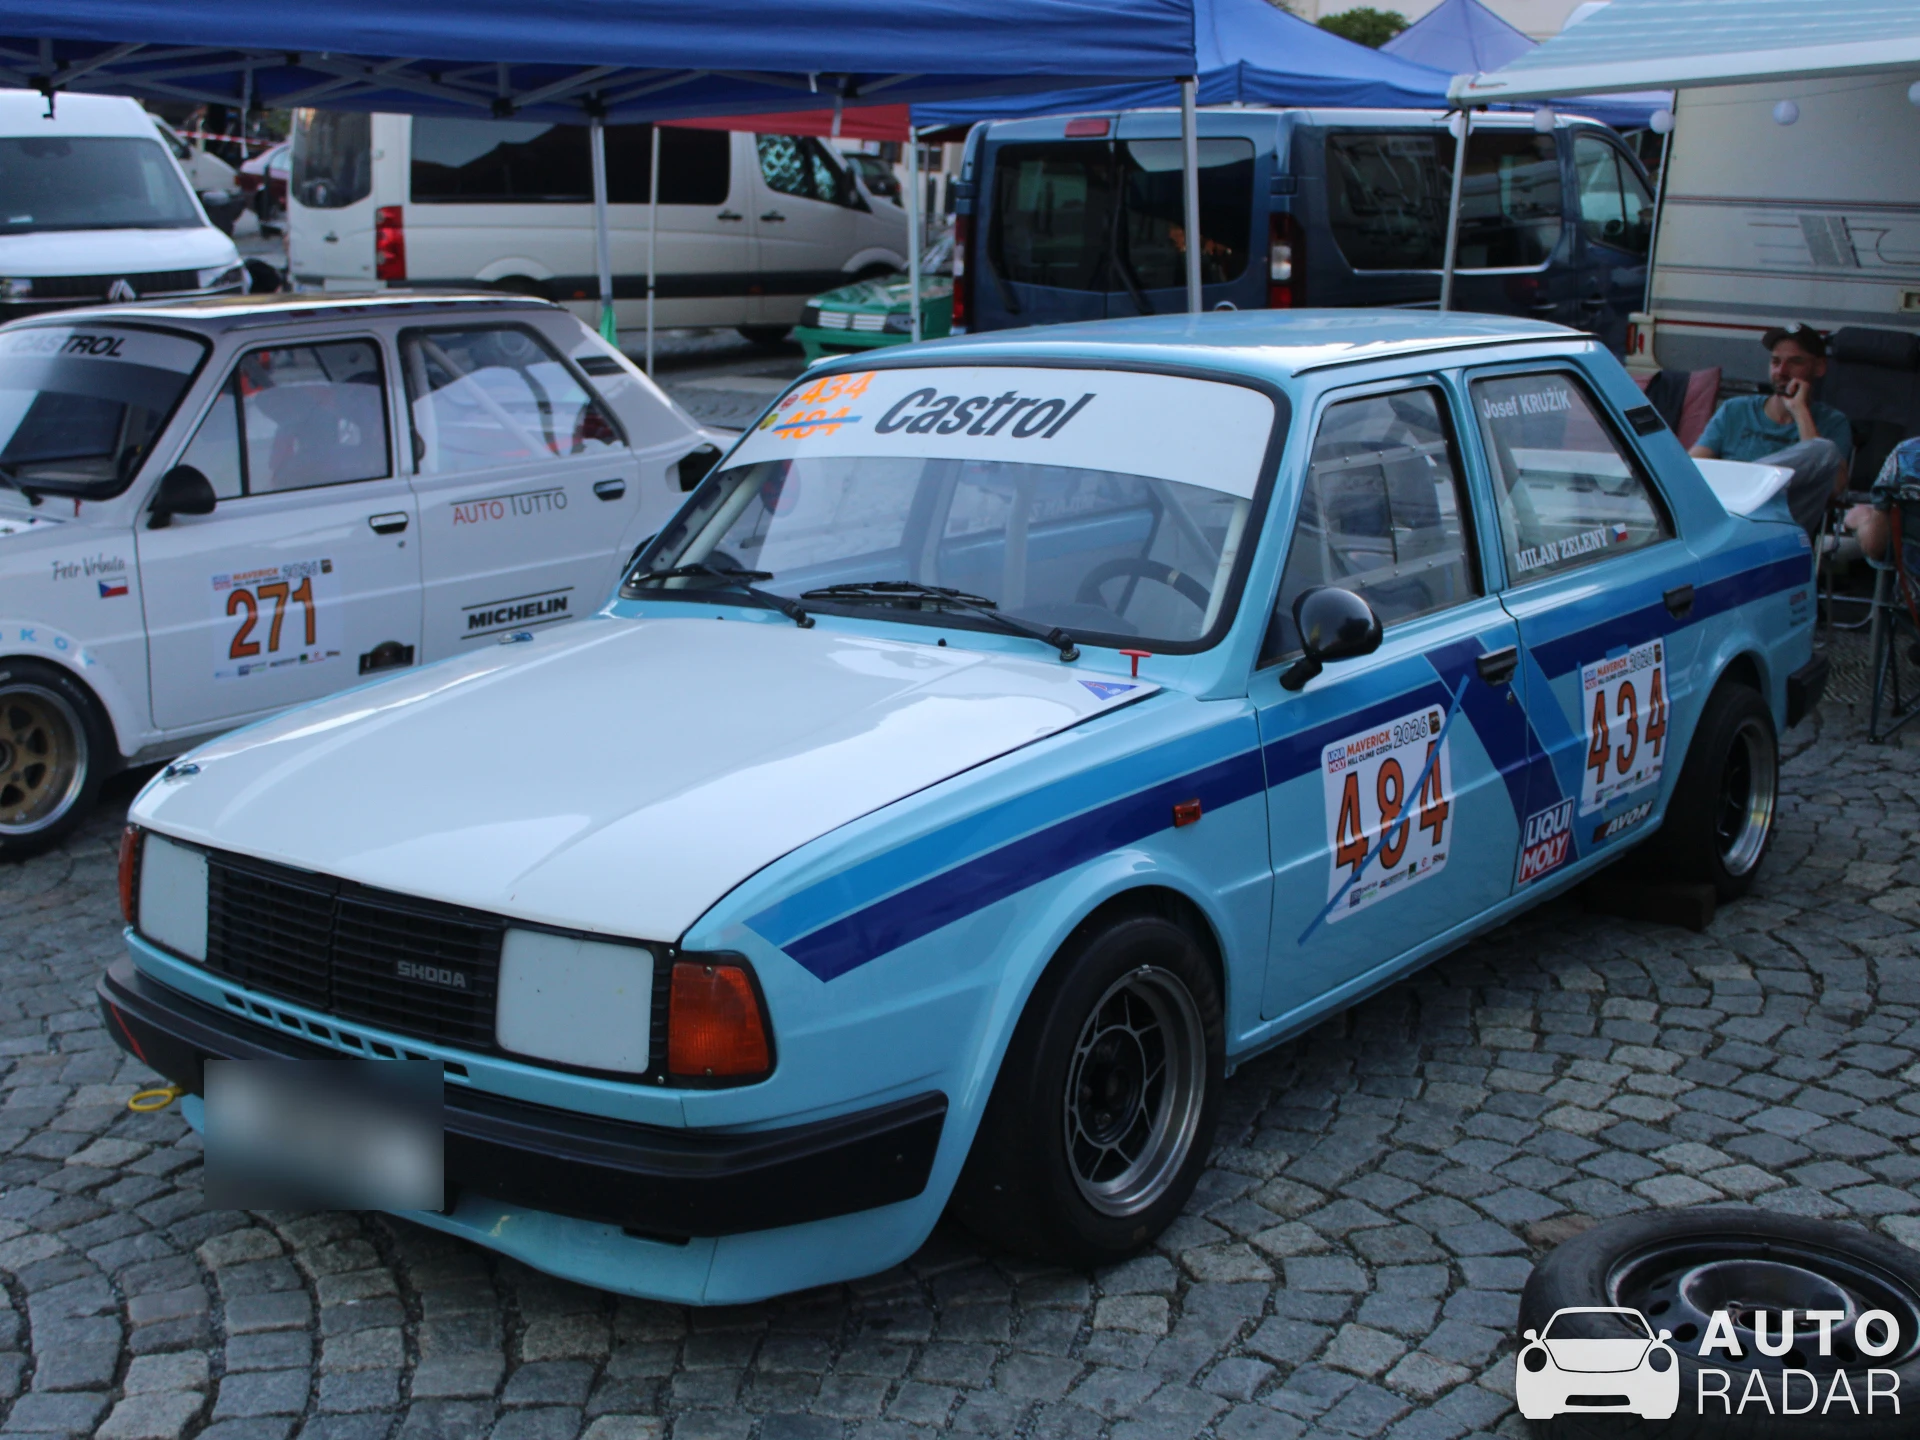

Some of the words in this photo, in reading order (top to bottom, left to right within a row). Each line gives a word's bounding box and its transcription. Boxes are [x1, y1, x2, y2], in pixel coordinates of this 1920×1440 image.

[800, 371, 877, 405] 434
[875, 387, 1097, 439] Castrol
[1483, 396, 1520, 419] Josef
[454, 500, 504, 526] AUTO
[509, 491, 568, 516] TUTTO
[1514, 541, 1559, 573] MILAN
[226, 577, 316, 660] 271
[468, 596, 568, 630] MICHELIN
[1346, 729, 1391, 757] MAVERICK
[1393, 716, 1428, 749] 2026
[1587, 667, 1666, 785] 434
[1347, 755, 1358, 767] HILL
[1336, 739, 1449, 883] 484
[1526, 802, 1572, 848] LIQUI
[1605, 801, 1653, 837] AVON
[1521, 833, 1568, 880] MOLY
